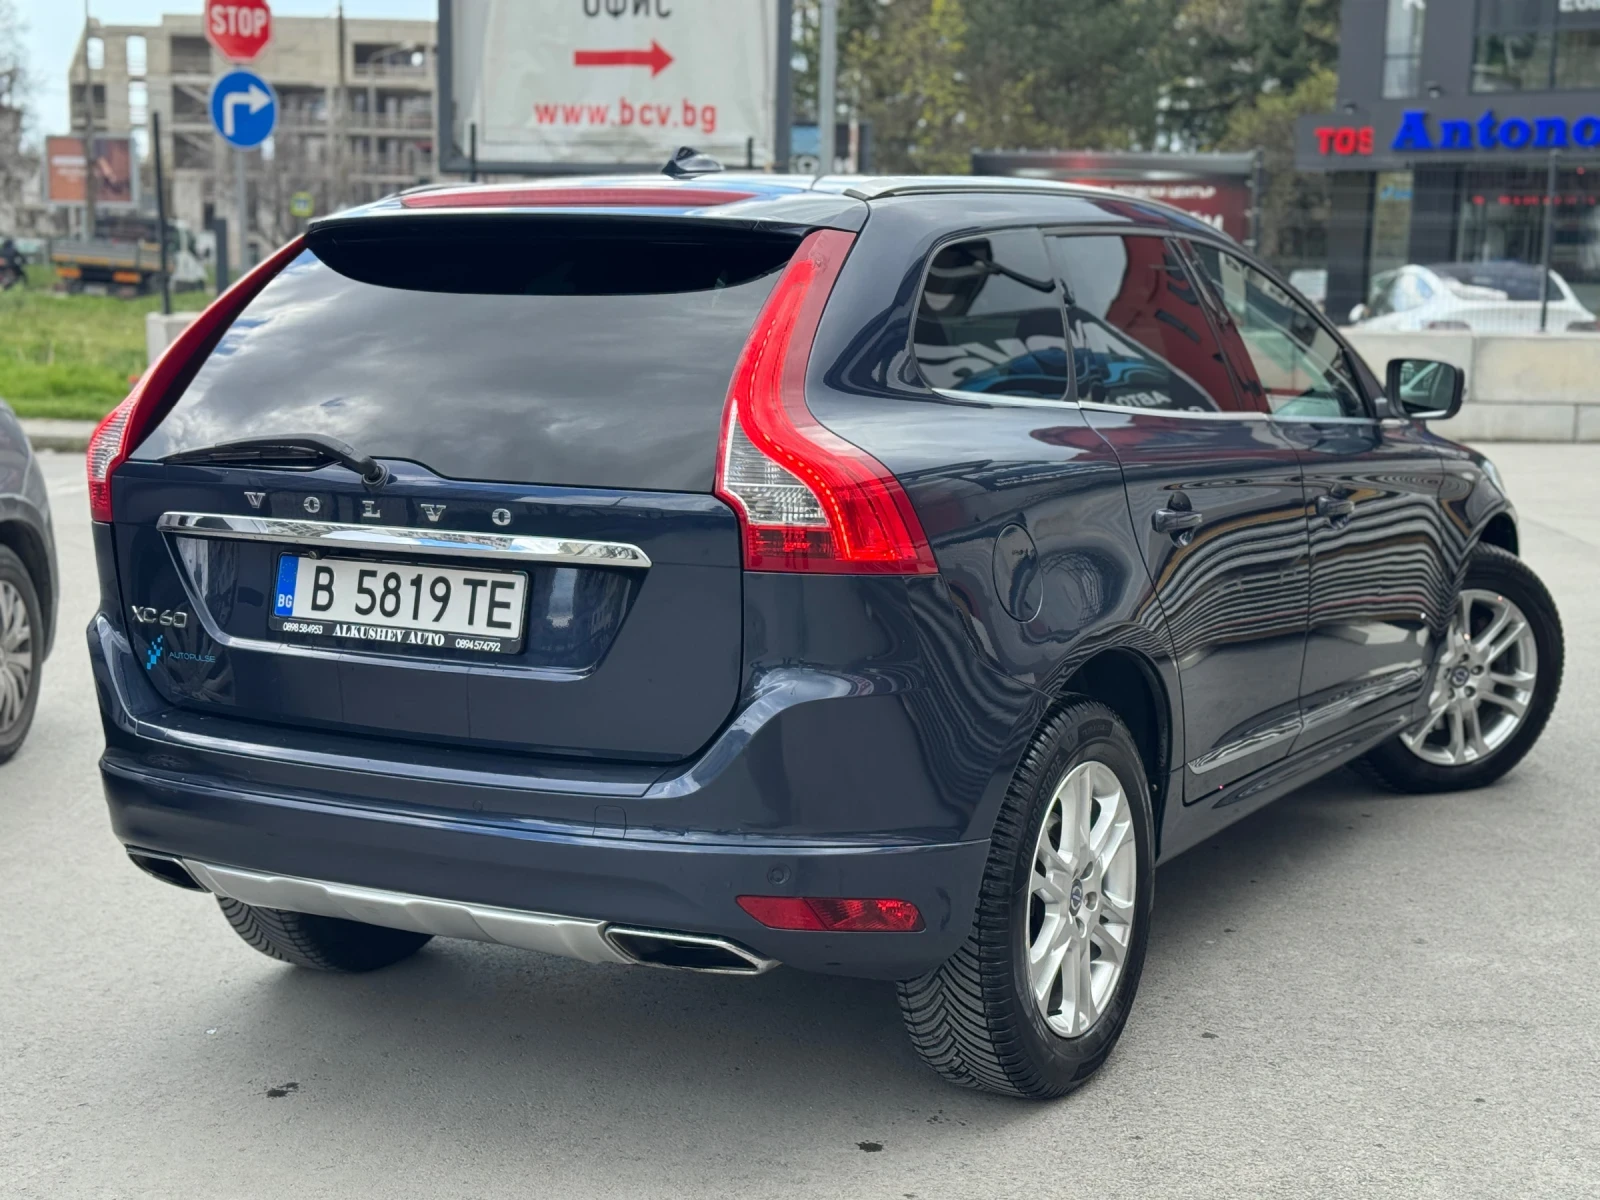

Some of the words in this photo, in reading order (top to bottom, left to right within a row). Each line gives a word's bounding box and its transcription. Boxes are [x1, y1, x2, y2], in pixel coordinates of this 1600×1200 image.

[211, 4, 267, 38] STOP
[534, 97, 716, 134] www.bcv.bg
[244, 491, 512, 527] VOLVO
[277, 593, 294, 609] BG
[311, 565, 335, 612] B
[354, 569, 452, 623] 5819
[462, 577, 516, 630] TE
[332, 623, 405, 643] ALKUSHEV
[407, 631, 446, 647] AUTO
[168, 651, 217, 664] AUTOPULSE
